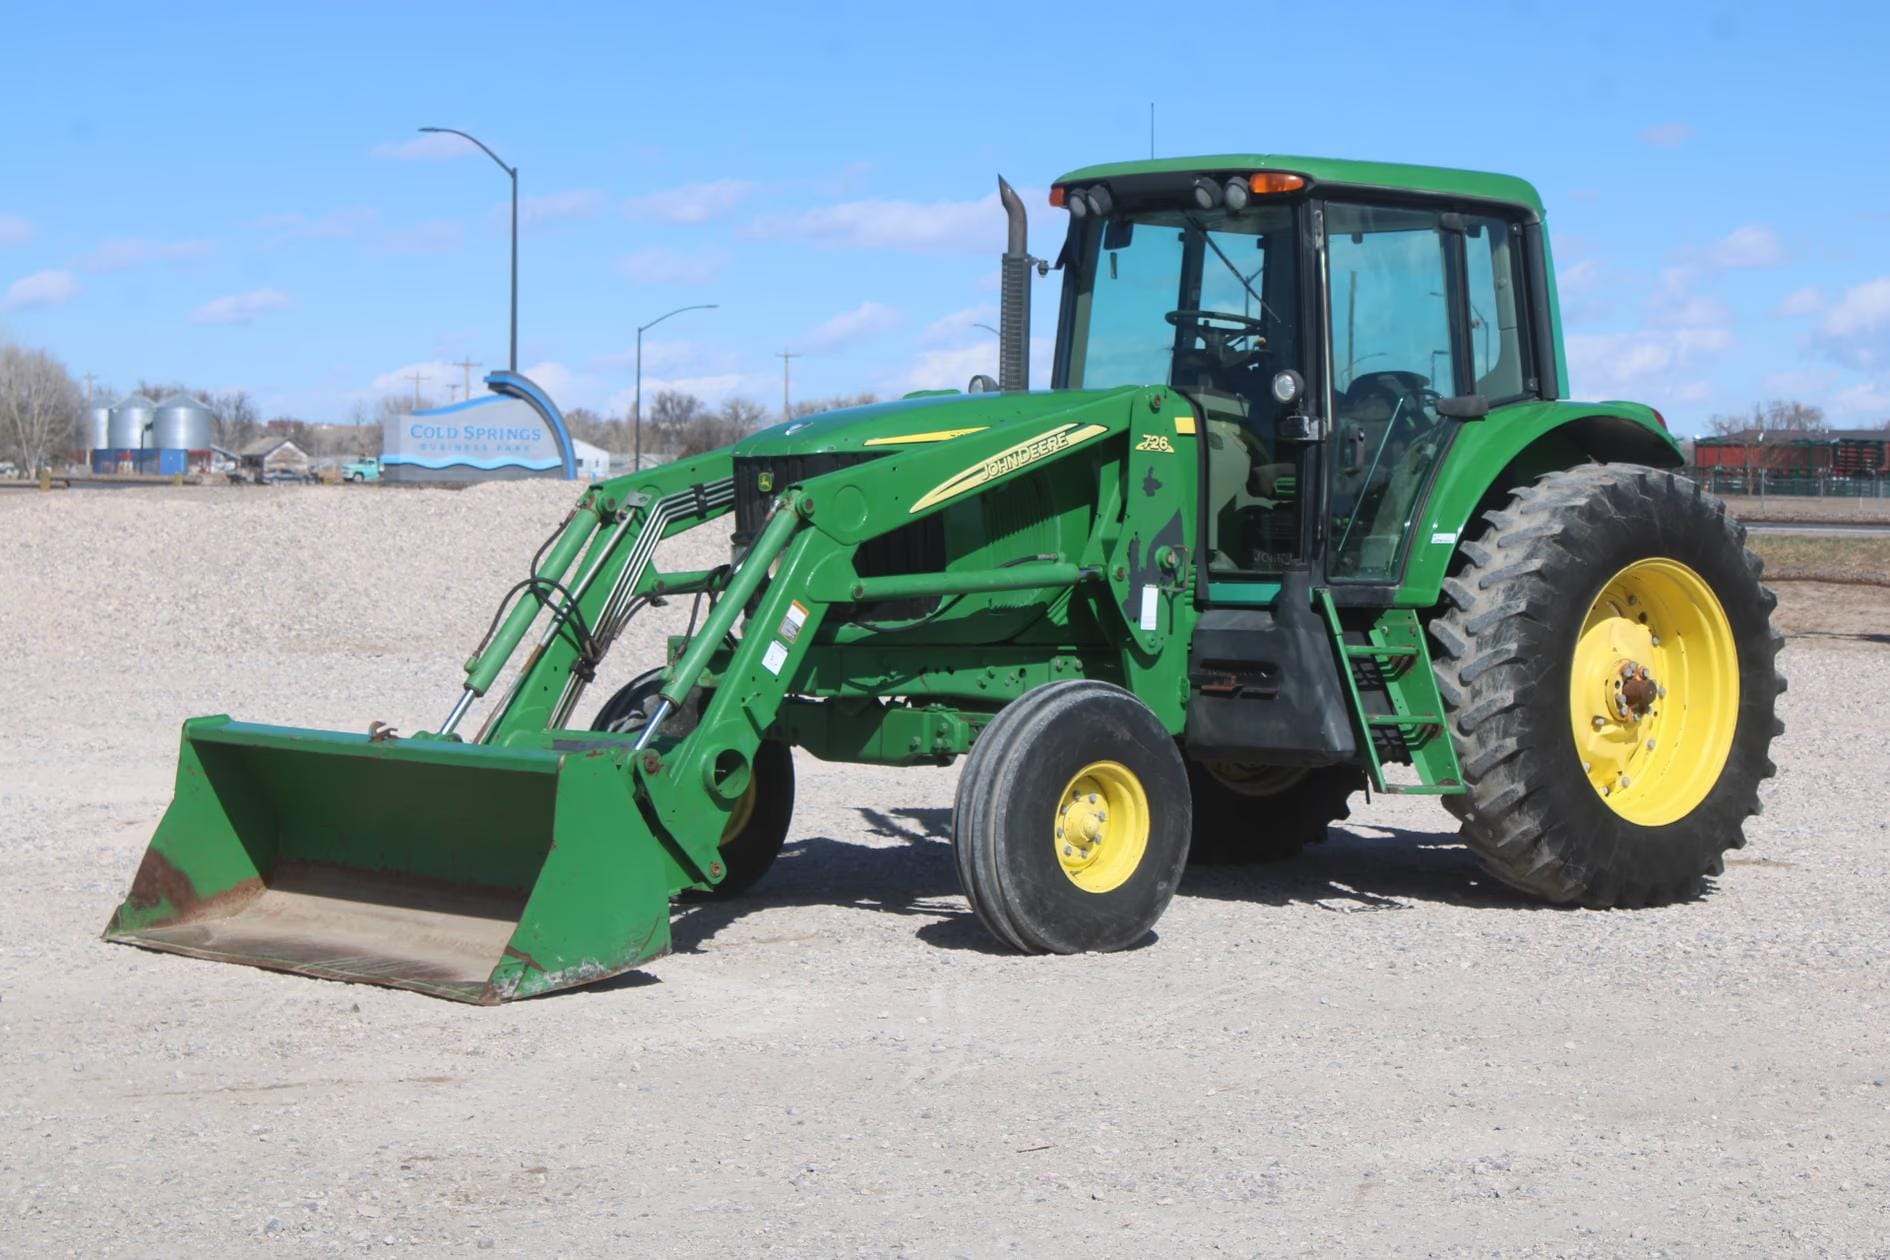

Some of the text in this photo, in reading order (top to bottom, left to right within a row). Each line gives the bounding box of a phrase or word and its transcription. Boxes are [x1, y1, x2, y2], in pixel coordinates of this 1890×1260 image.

[410, 424, 541, 441] COLD SPRINGS
[1142, 434, 1168, 450] 726
[982, 432, 1069, 480] JOHN DEERE
